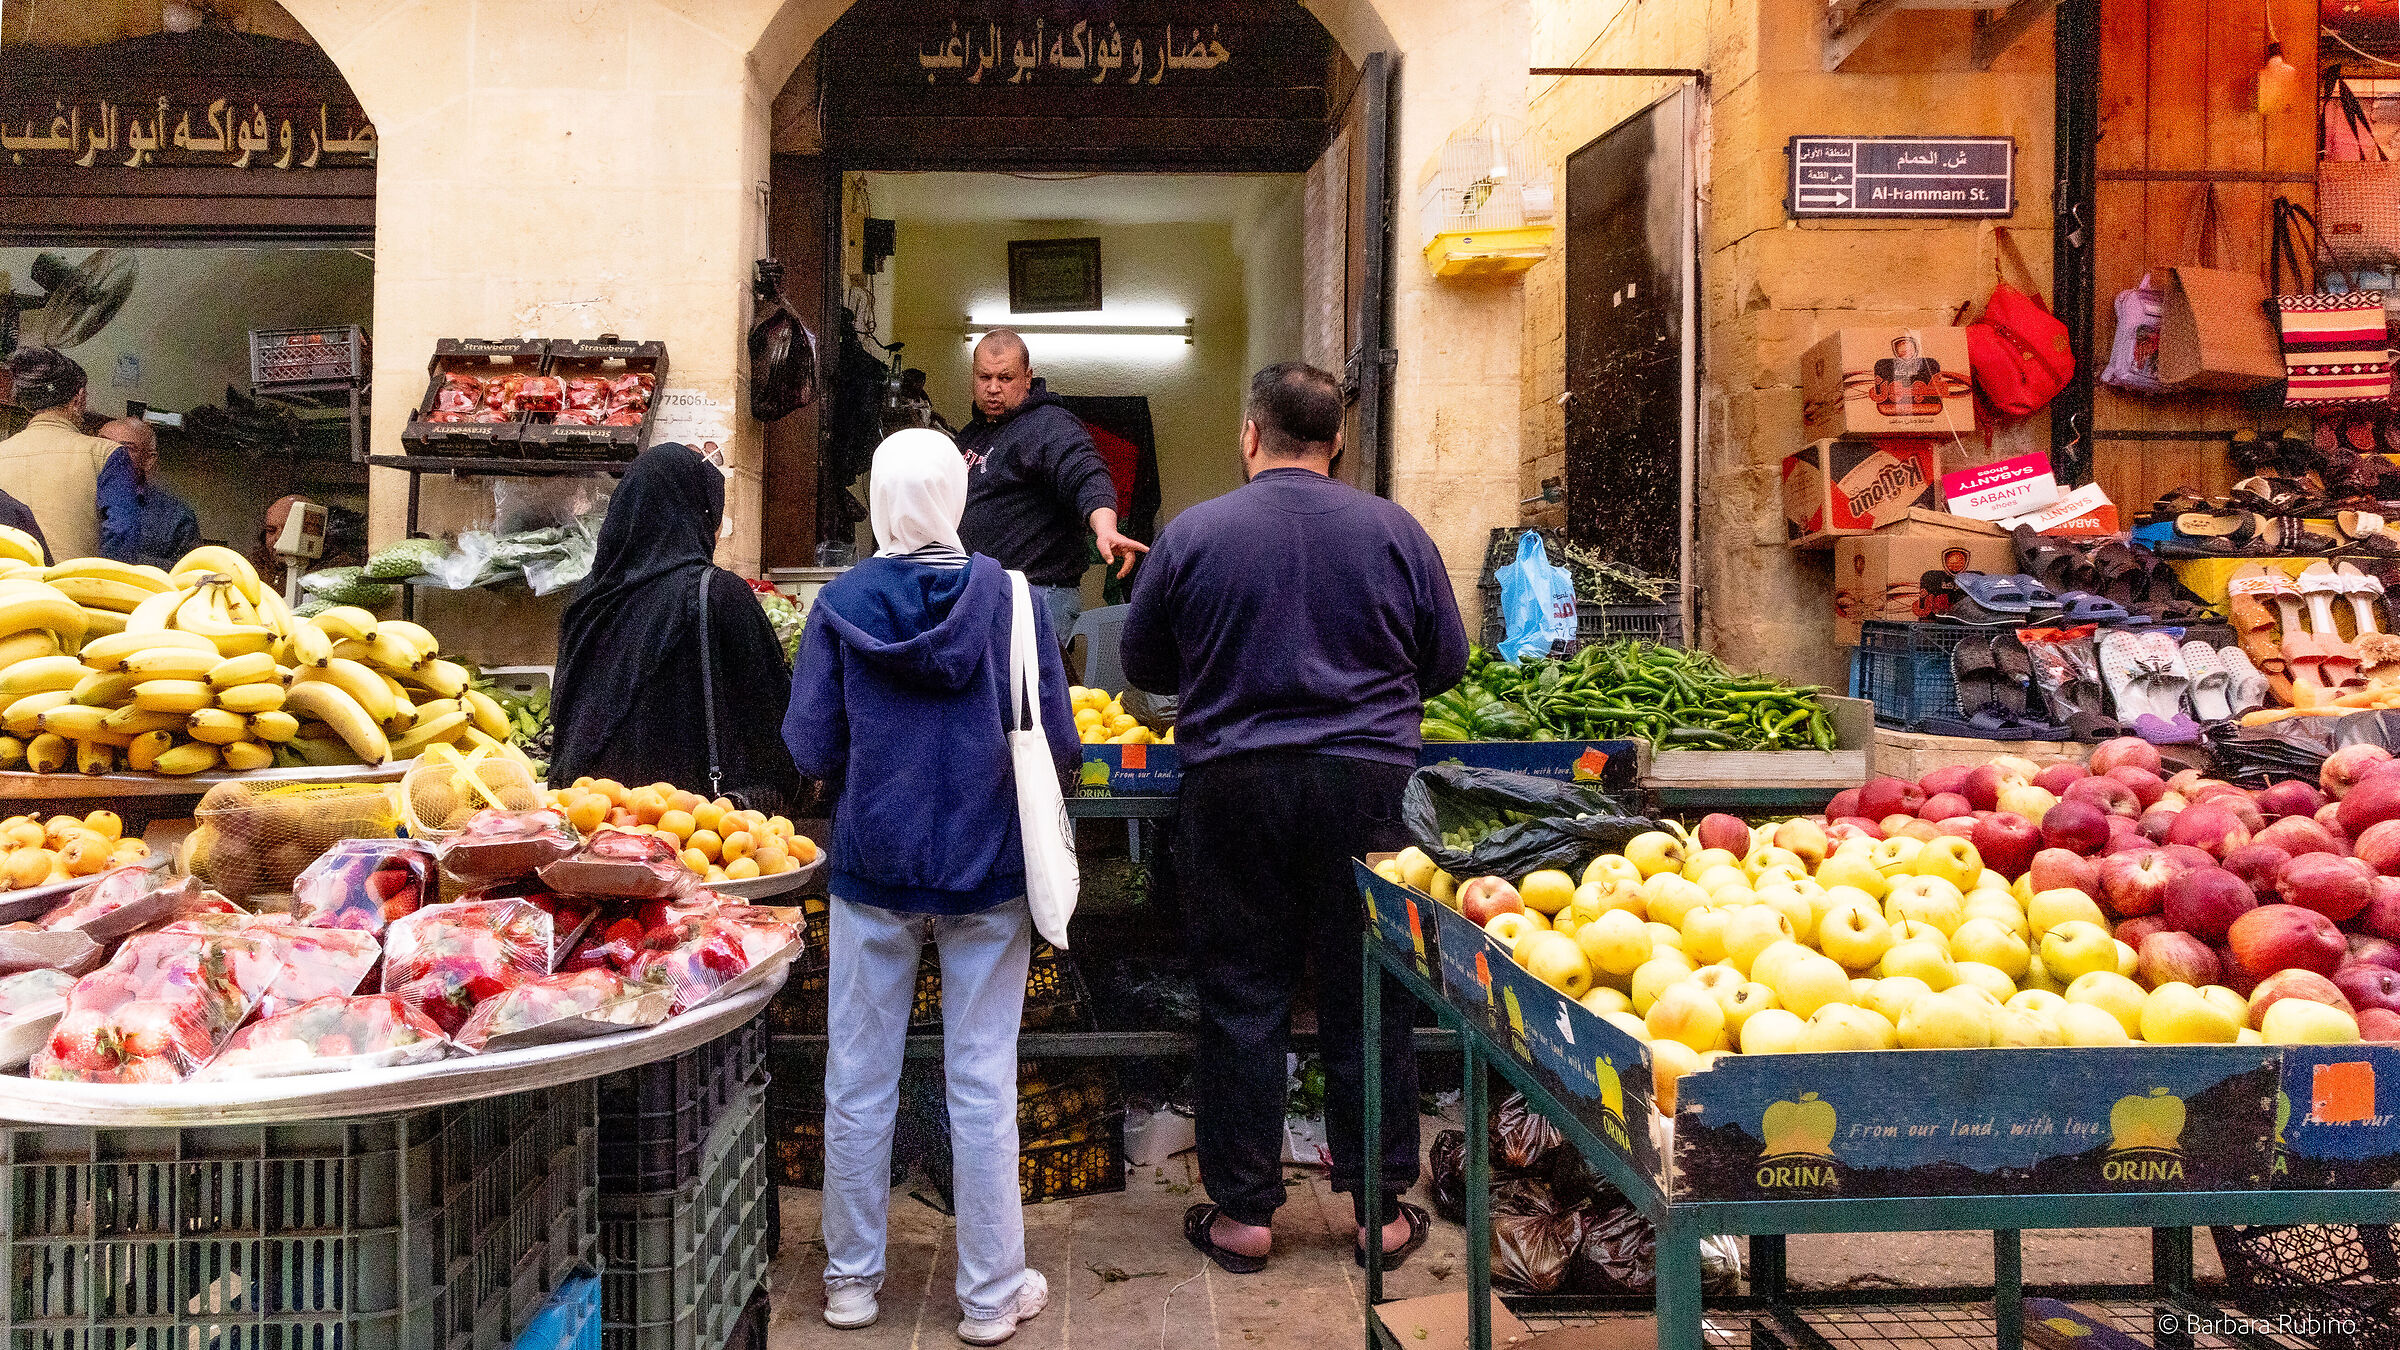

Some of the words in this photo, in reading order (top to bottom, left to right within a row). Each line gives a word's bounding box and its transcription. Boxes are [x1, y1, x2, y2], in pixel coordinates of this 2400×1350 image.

[919, 20, 1002, 84] الراغب
[1007, 18, 1044, 83] أبو
[1050, 19, 1122, 83] فواكه
[1128, 38, 1143, 84] و
[1148, 23, 1230, 84] خضار
[1, 98, 119, 167] الراغب
[123, 96, 168, 167] أبو
[174, 98, 269, 168] فواكه
[273, 120, 292, 168] و
[300, 103, 377, 168] ضار
[1897, 151, 1938, 169] الحمام
[1871, 187, 1966, 201] Al-Hammam
[1970, 187, 1989, 201] St.
[463, 343, 520, 352] Strawberry
[579, 344, 635, 353] Strawberry
[1958, 466, 2034, 491] SABANTY
[1977, 465, 2009, 477] shoes
[1970, 483, 2033, 507] SABANTY
[1991, 500, 2018, 511] shoes
[2041, 497, 2092, 523] SABANTY
[1114, 771, 1135, 779] From
[1080, 788, 1112, 798] ORINA
[1602, 1115, 1633, 1155] ORINA
[1848, 1121, 1898, 1137] From
[1909, 1123, 1940, 1137] our
[1950, 1117, 1999, 1139] land,
[2010, 1115, 2053, 1137] with
[2064, 1117, 2106, 1138] love.
[1756, 1160, 1839, 1188] ORINA
[2102, 1160, 2185, 1181] ORINA
